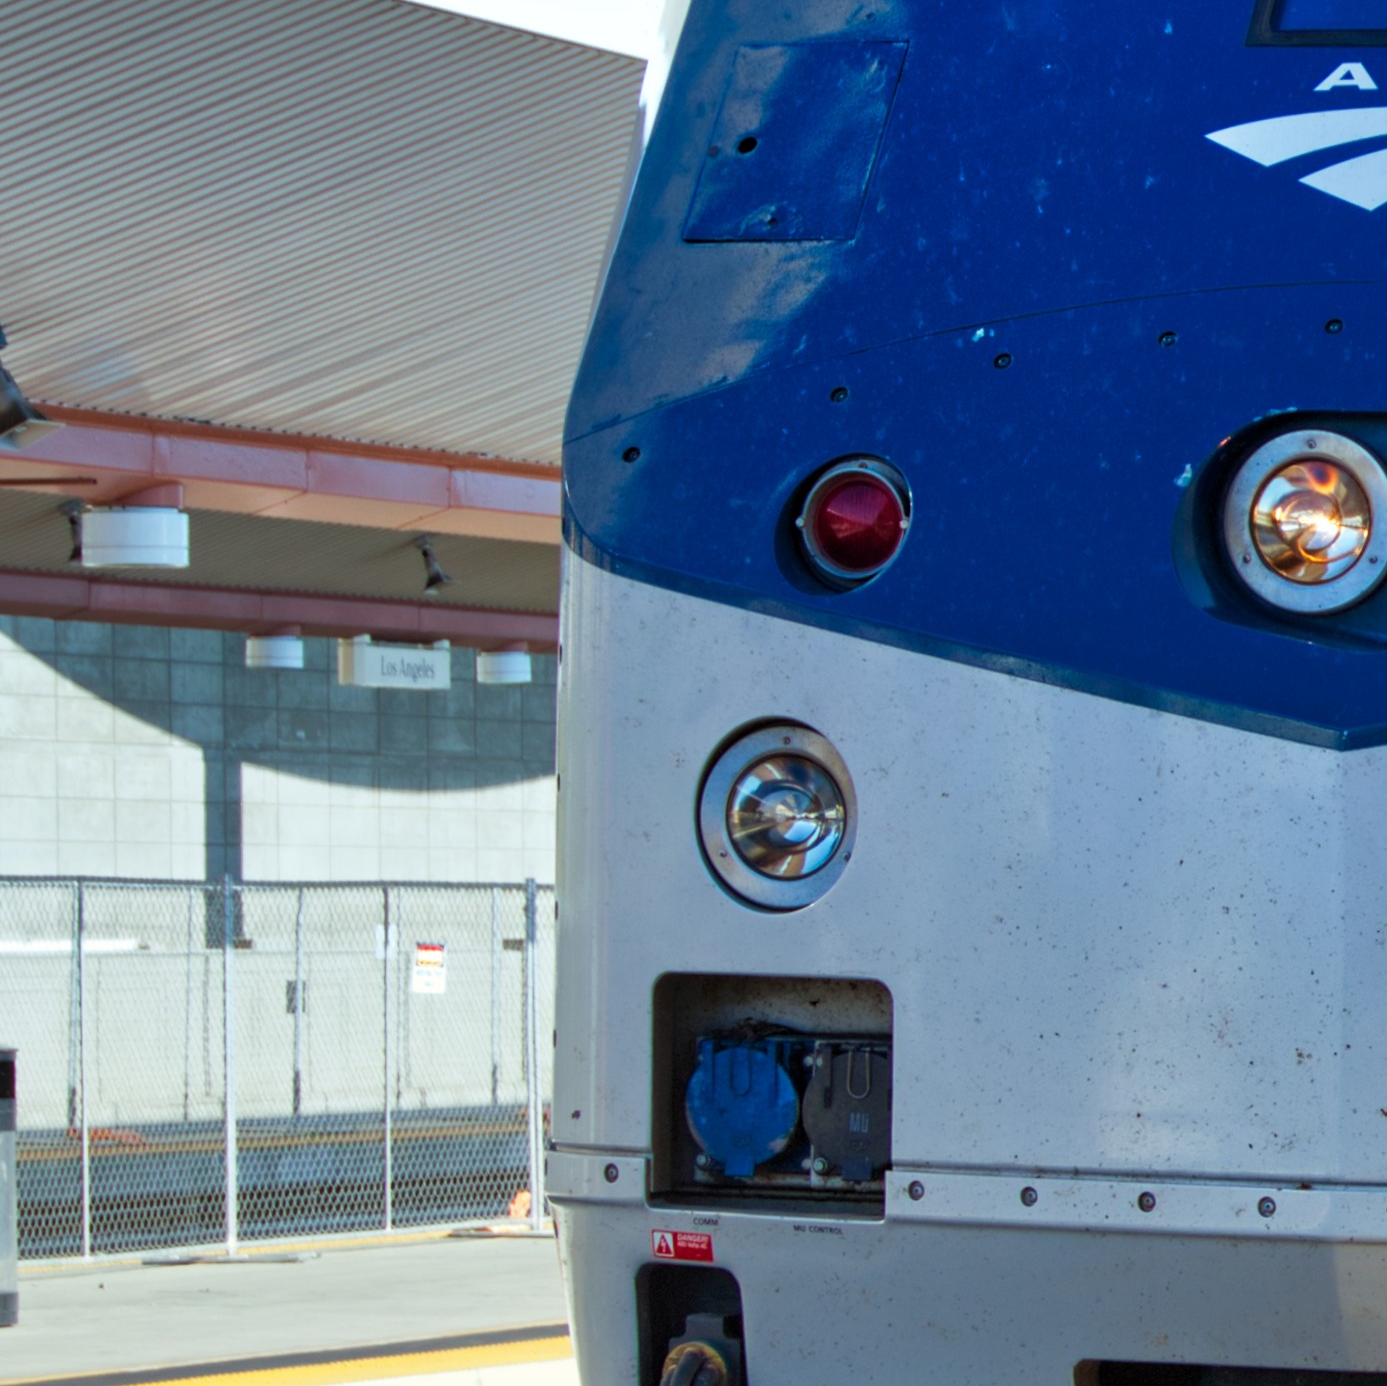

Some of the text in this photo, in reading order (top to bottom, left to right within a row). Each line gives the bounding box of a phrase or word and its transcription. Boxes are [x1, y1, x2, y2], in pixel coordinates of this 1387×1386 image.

[380, 654, 435, 684] Los Angeles
[692, 1217, 720, 1226] COMM
[793, 1224, 844, 1235] MU CONTROL
